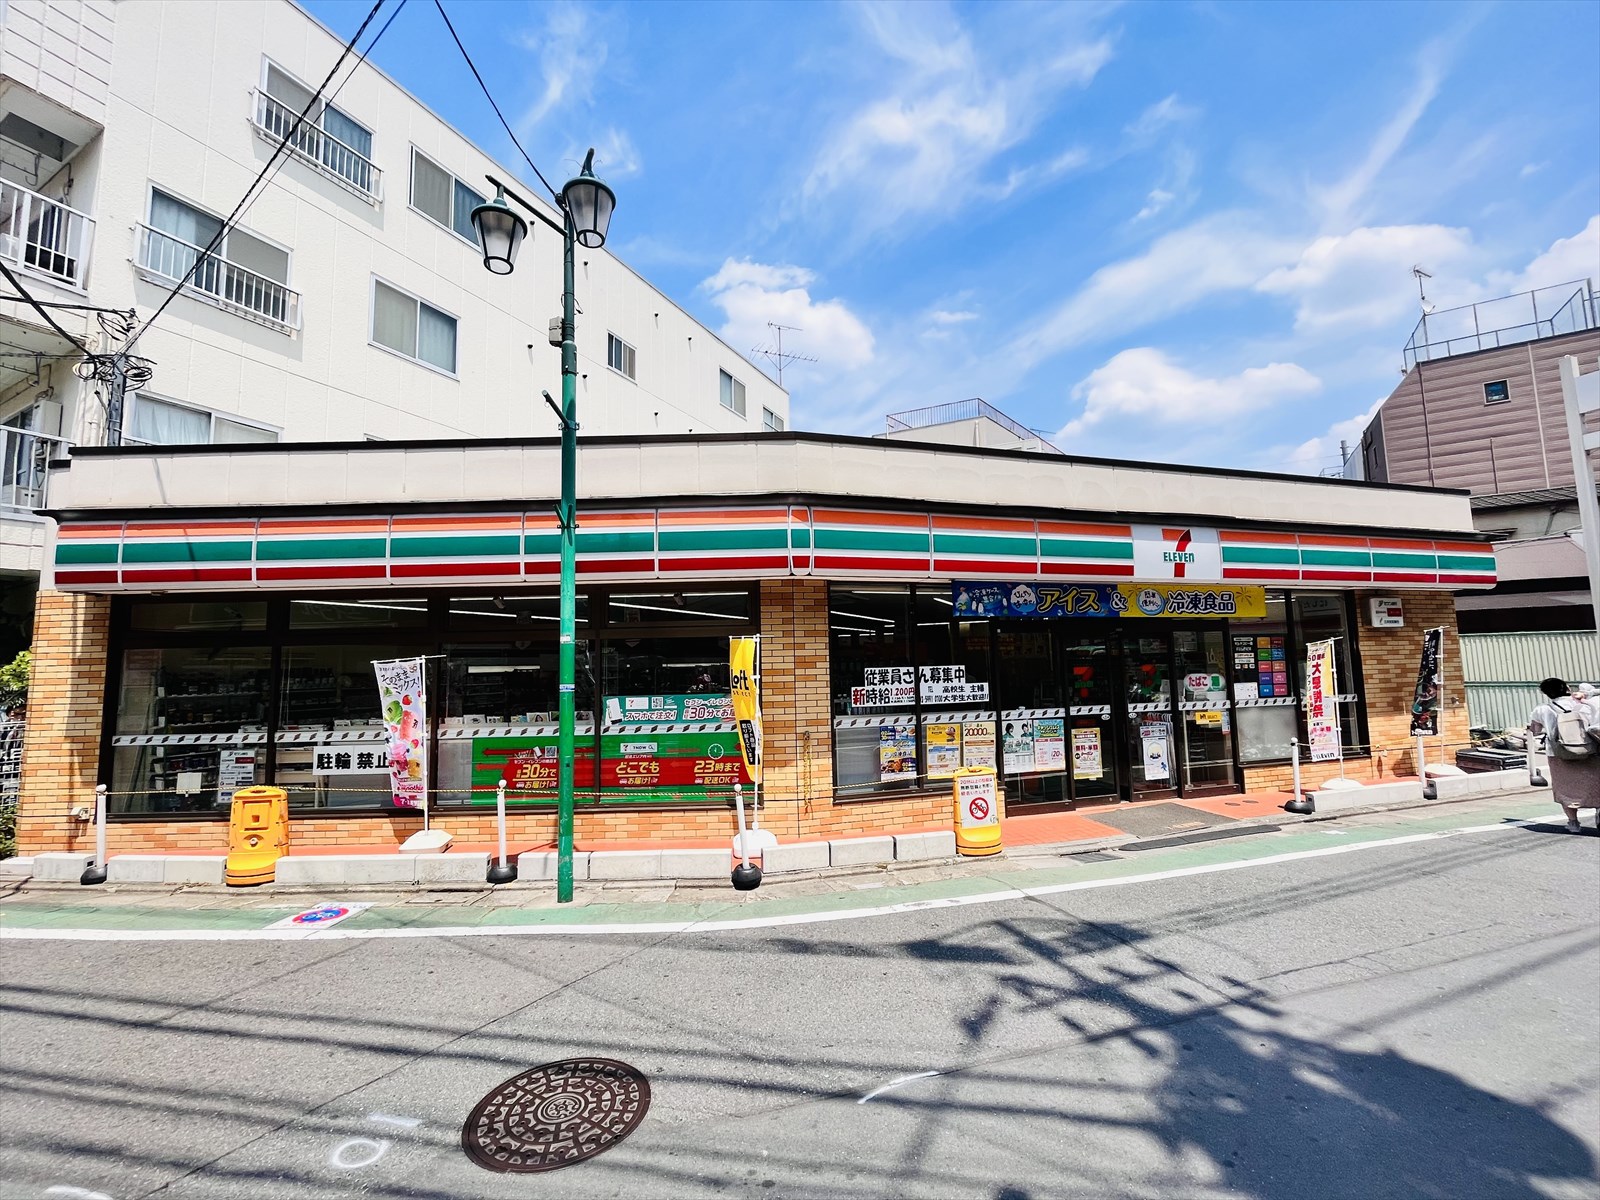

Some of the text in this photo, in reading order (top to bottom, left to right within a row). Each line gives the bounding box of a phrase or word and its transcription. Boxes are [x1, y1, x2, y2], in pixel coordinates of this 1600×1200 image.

[1038, 589, 1100, 612] アイス
[1167, 591, 1236, 614] 冷凍食品
[1188, 676, 1209, 687] たばこ
[616, 761, 659, 773] どこでも
[694, 761, 740, 773] 23時まで
